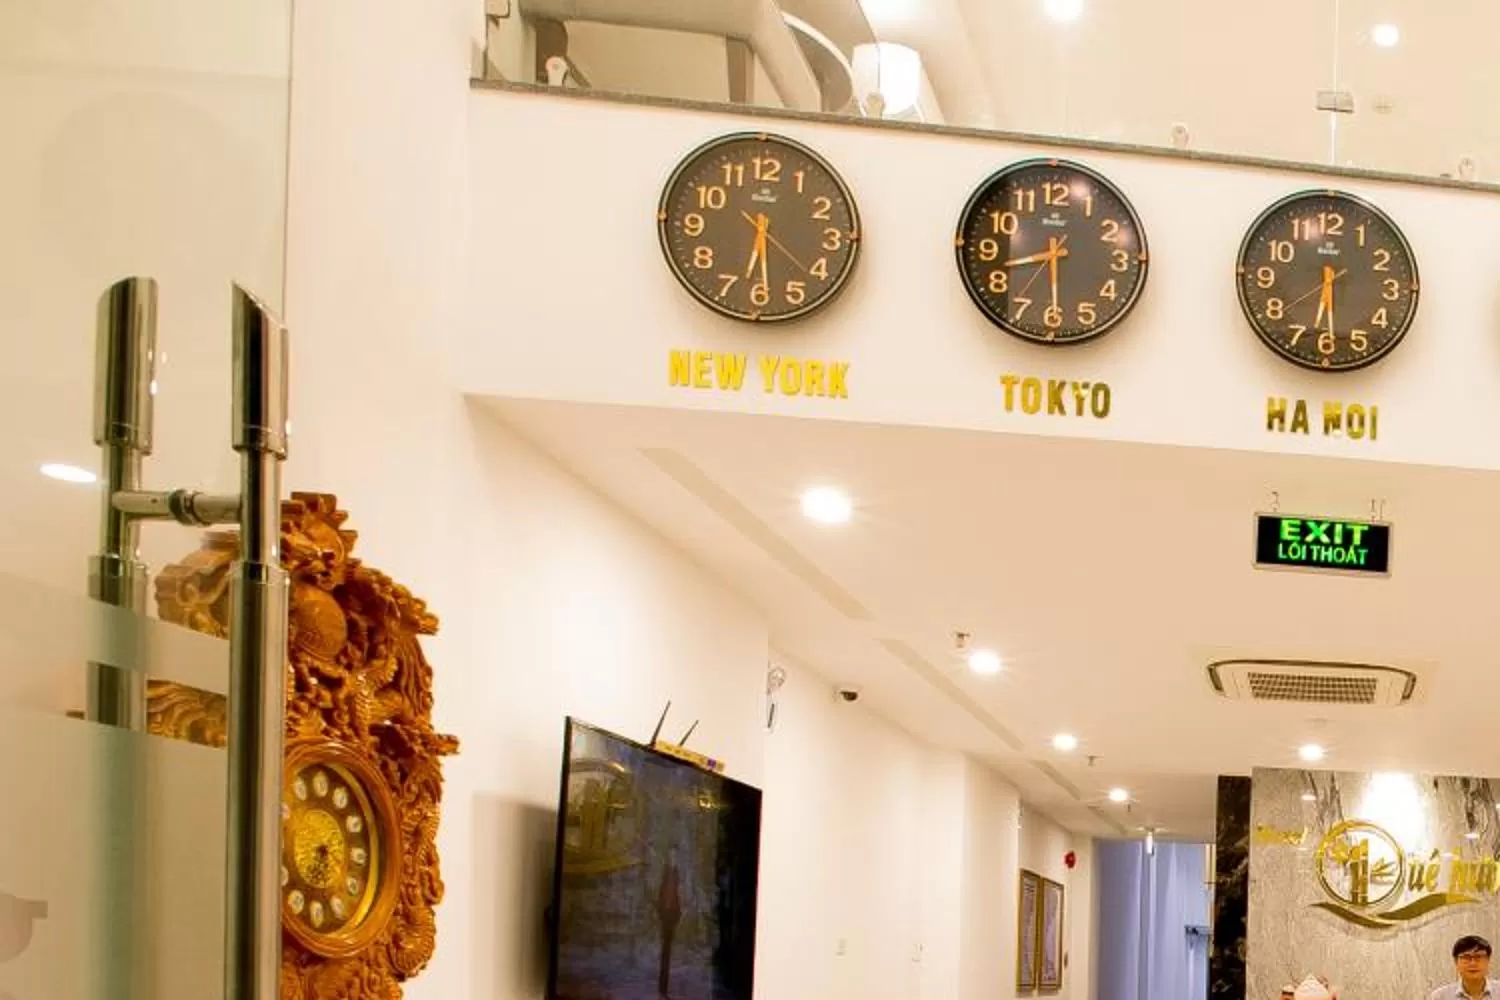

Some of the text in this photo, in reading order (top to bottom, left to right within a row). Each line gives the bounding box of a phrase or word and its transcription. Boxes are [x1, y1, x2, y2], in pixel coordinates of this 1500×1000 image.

[721, 162, 745, 188] 11
[751, 156, 782, 182] 12
[793, 171, 804, 193] 1
[696, 185, 726, 210] 10
[1014, 187, 1036, 212] 11
[1042, 182, 1070, 207] 12
[1083, 195, 1092, 217] 1
[811, 196, 832, 221] 2
[683, 213, 705, 237] 9
[990, 210, 1019, 236] 10
[1100, 219, 1119, 243] 2
[1291, 218, 1310, 241] 11
[1317, 212, 1344, 236] 12
[821, 227, 841, 251] 3
[1355, 224, 1365, 247] 1
[692, 245, 713, 269] 8
[979, 238, 999, 261] 9
[1110, 250, 1129, 272] 3
[1268, 239, 1295, 263] 10
[1373, 249, 1391, 271] 2
[809, 257, 829, 281] 4
[1256, 266, 1275, 289] 9
[718, 274, 739, 297] 7
[785, 281, 806, 304] 5
[989, 271, 1008, 293] 8
[1100, 279, 1117, 301] 4
[1382, 279, 1400, 301] 3
[750, 283, 769, 306] 6
[1013, 297, 1033, 320] 7
[1043, 306, 1063, 328] 6
[1077, 302, 1097, 325] 5
[1265, 297, 1283, 320] 8
[1371, 307, 1389, 329] 4
[1288, 324, 1307, 346] 7
[1317, 332, 1335, 354] 6
[1350, 330, 1368, 351] 5
[668, 350, 850, 399] NEW YORK
[1000, 375, 1111, 419] TOKYO
[1266, 397, 1378, 441] HA NOI
[1280, 519, 1369, 545] EXIT
